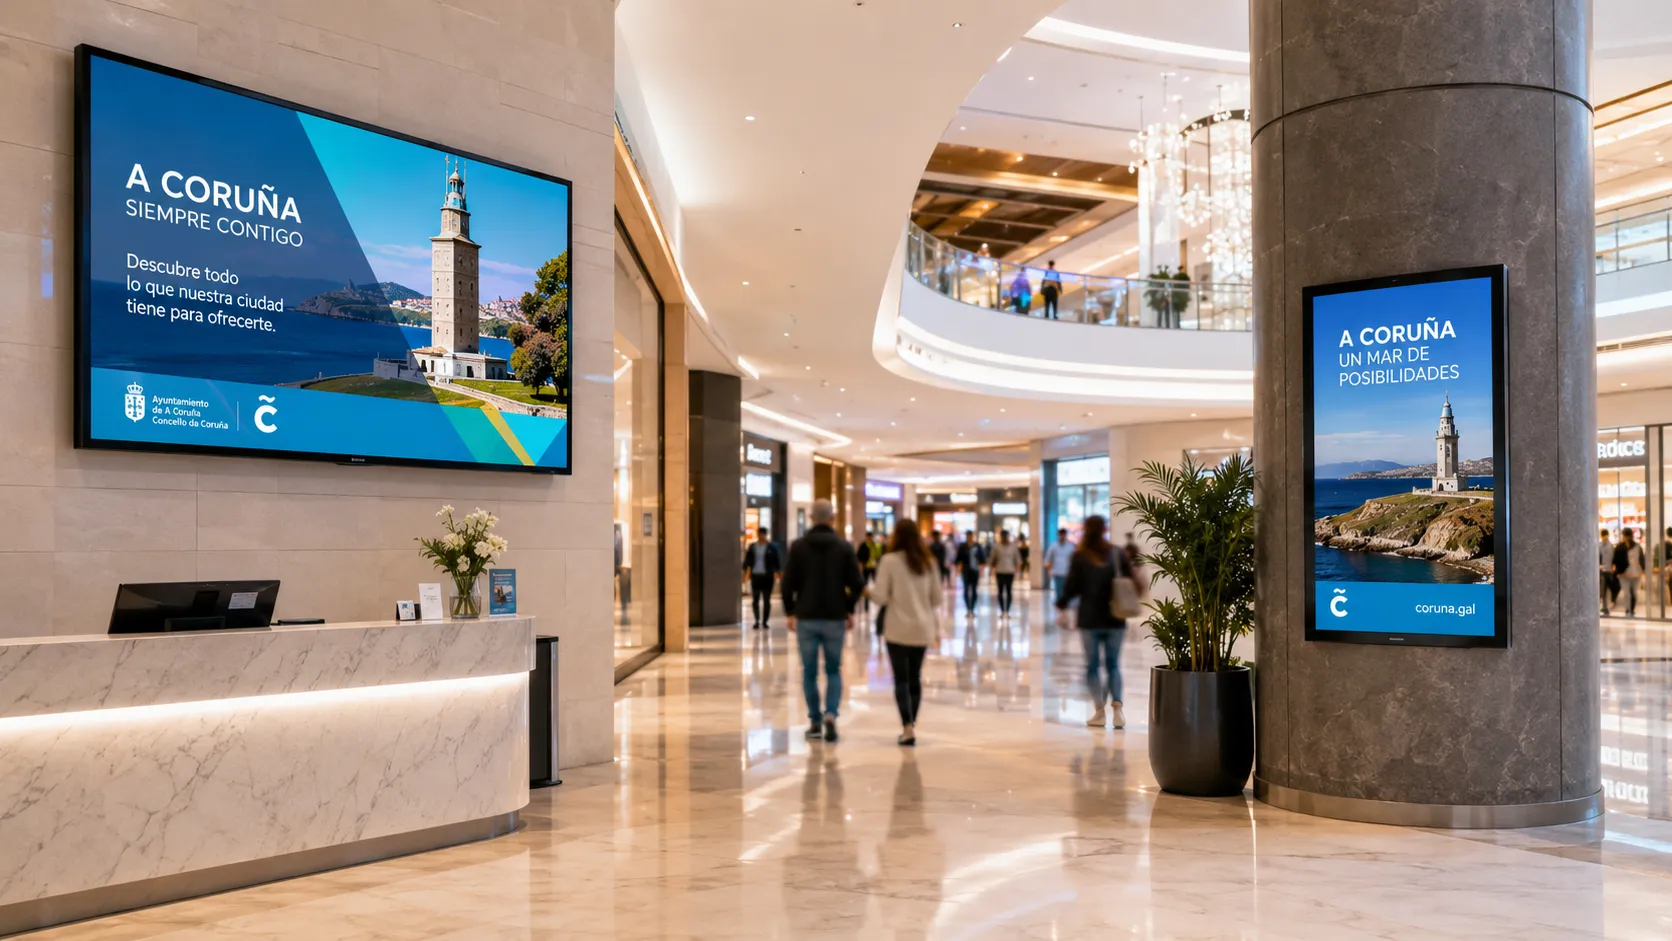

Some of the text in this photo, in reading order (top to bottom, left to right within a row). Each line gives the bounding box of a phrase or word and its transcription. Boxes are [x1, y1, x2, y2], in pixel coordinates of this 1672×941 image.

[126, 163, 302, 224] A CORUÑA
[126, 199, 303, 247] SIEMPRE CONTIGO
[127, 253, 239, 285] Descubre todo
[127, 275, 284, 312] lo que nuestra ciudad
[126, 299, 276, 332] tiene para ofrecerte.
[1339, 317, 1457, 347] A CORUÑA
[1339, 346, 1430, 367] UN MAR DE
[1339, 364, 1460, 387] POSIBILIDADES
[152, 395, 209, 408] Ayuntamiento
[152, 406, 162, 415] de
[165, 407, 171, 415] A
[152, 416, 187, 426] Concello
[1415, 603, 1476, 617] coruna.gal
